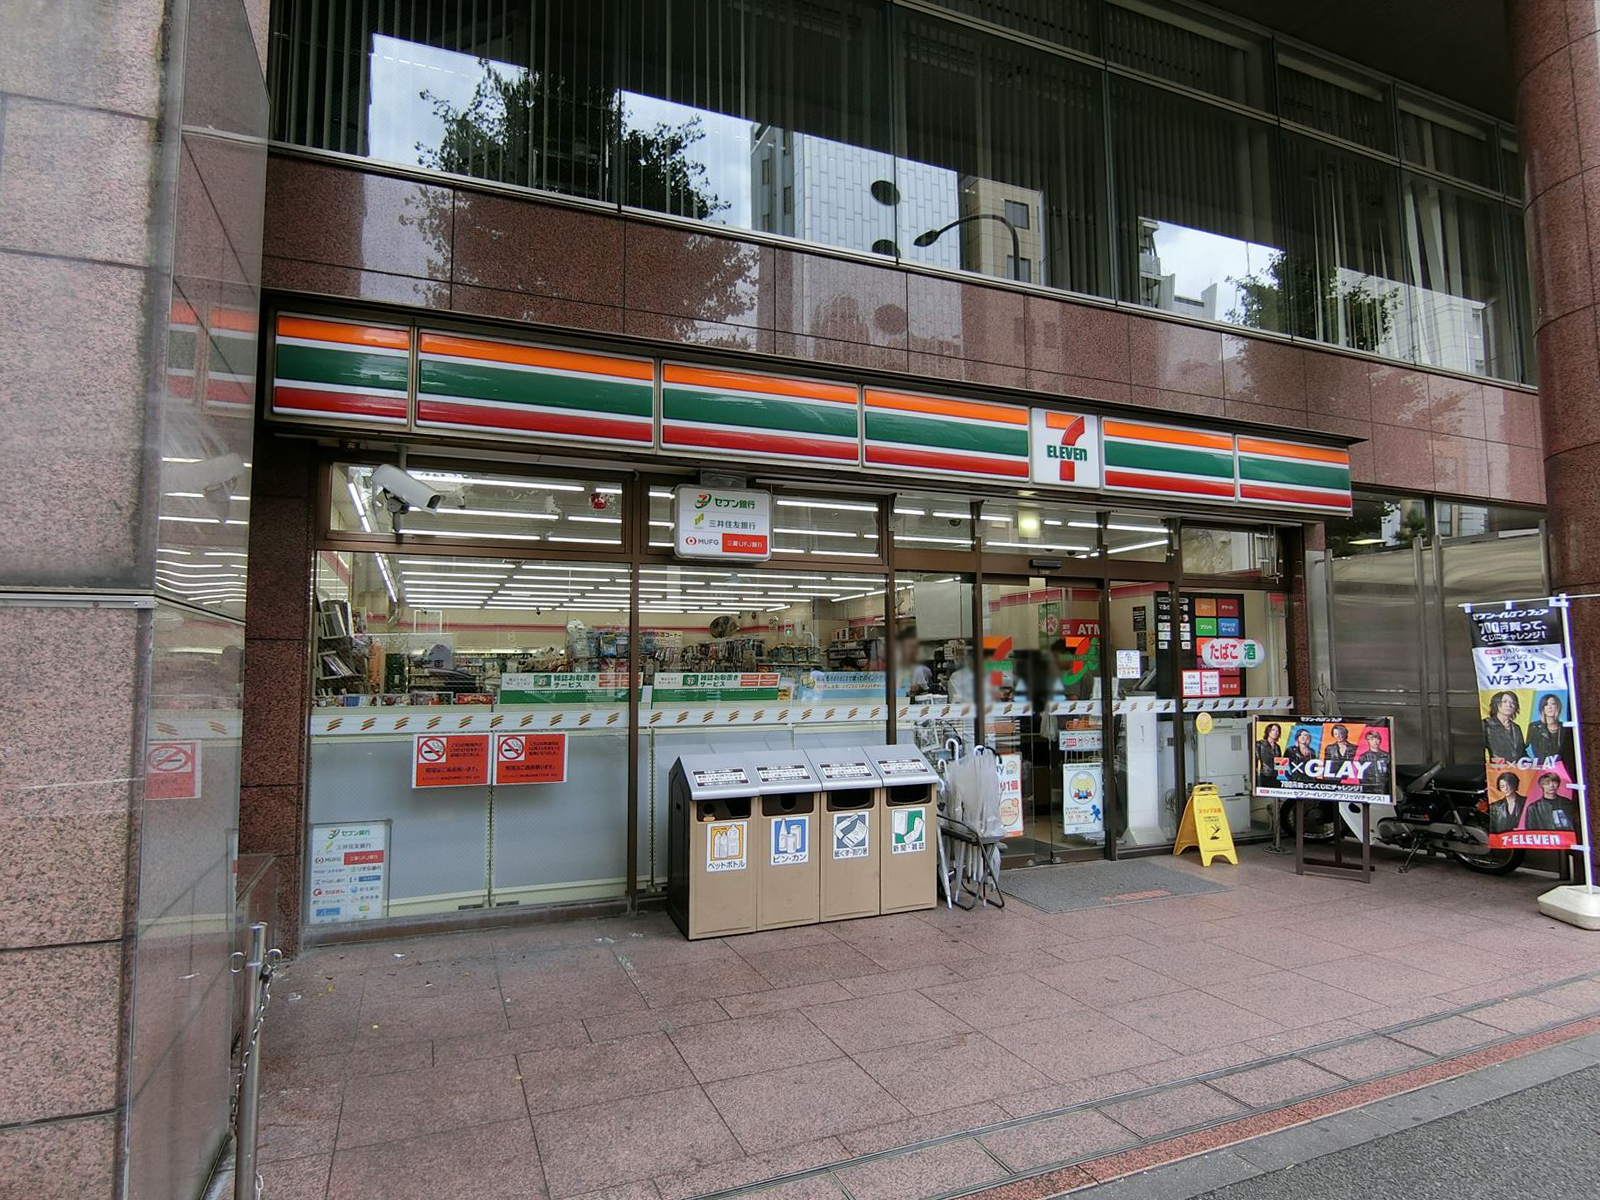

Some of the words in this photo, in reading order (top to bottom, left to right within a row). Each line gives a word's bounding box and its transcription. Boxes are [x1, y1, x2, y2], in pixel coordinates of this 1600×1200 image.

[714, 498, 755, 510] セブン銀行
[709, 520, 756, 530] 三井住友銀行
[698, 538, 719, 546] MUFG
[727, 540, 763, 548] 三菱UFJ銀行
[1210, 643, 1239, 660] たばこ
[1244, 643, 1256, 660] 酒
[1492, 660, 1546, 674] アプリで
[1487, 673, 1554, 685] Wチャンス!
[1517, 754, 1559, 771] GLAY
[1304, 759, 1372, 779] GLAY
[707, 860, 746, 869] ペットボトル
